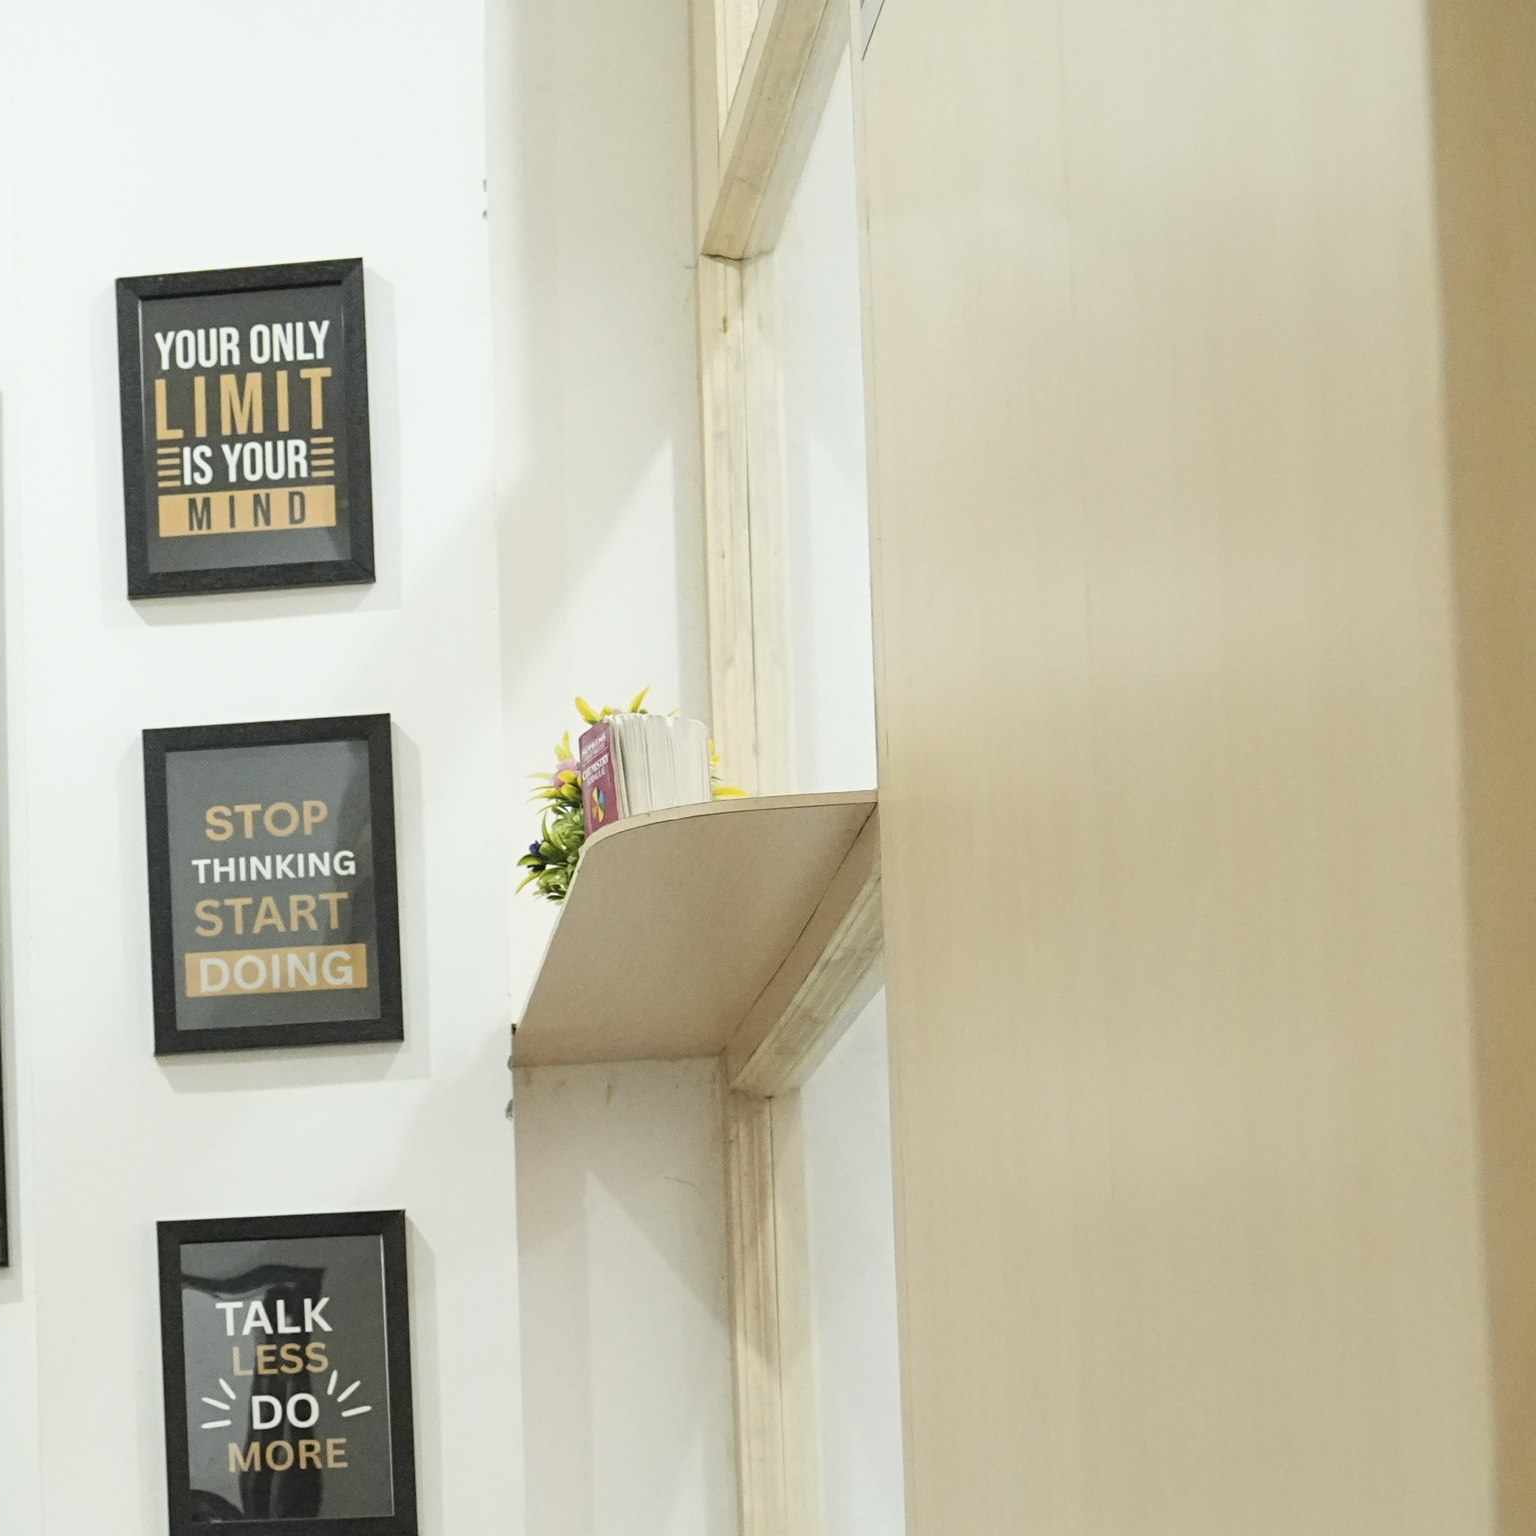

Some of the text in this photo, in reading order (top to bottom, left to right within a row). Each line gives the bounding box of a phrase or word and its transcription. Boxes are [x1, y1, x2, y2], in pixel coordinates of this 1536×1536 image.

[154, 320, 330, 370] YOUR ONLY
[155, 367, 332, 440] LIMIT
[182, 439, 308, 486] IS YOUR
[188, 490, 306, 531] MIND
[205, 800, 328, 841] STOP
[191, 850, 356, 884] THINKING
[194, 892, 349, 937] START
[200, 950, 355, 993] DOING
[215, 1297, 333, 1336] TALK
[232, 1342, 329, 1376] LESS
[251, 1392, 320, 1431] DO
[228, 1437, 348, 1473] MORE
